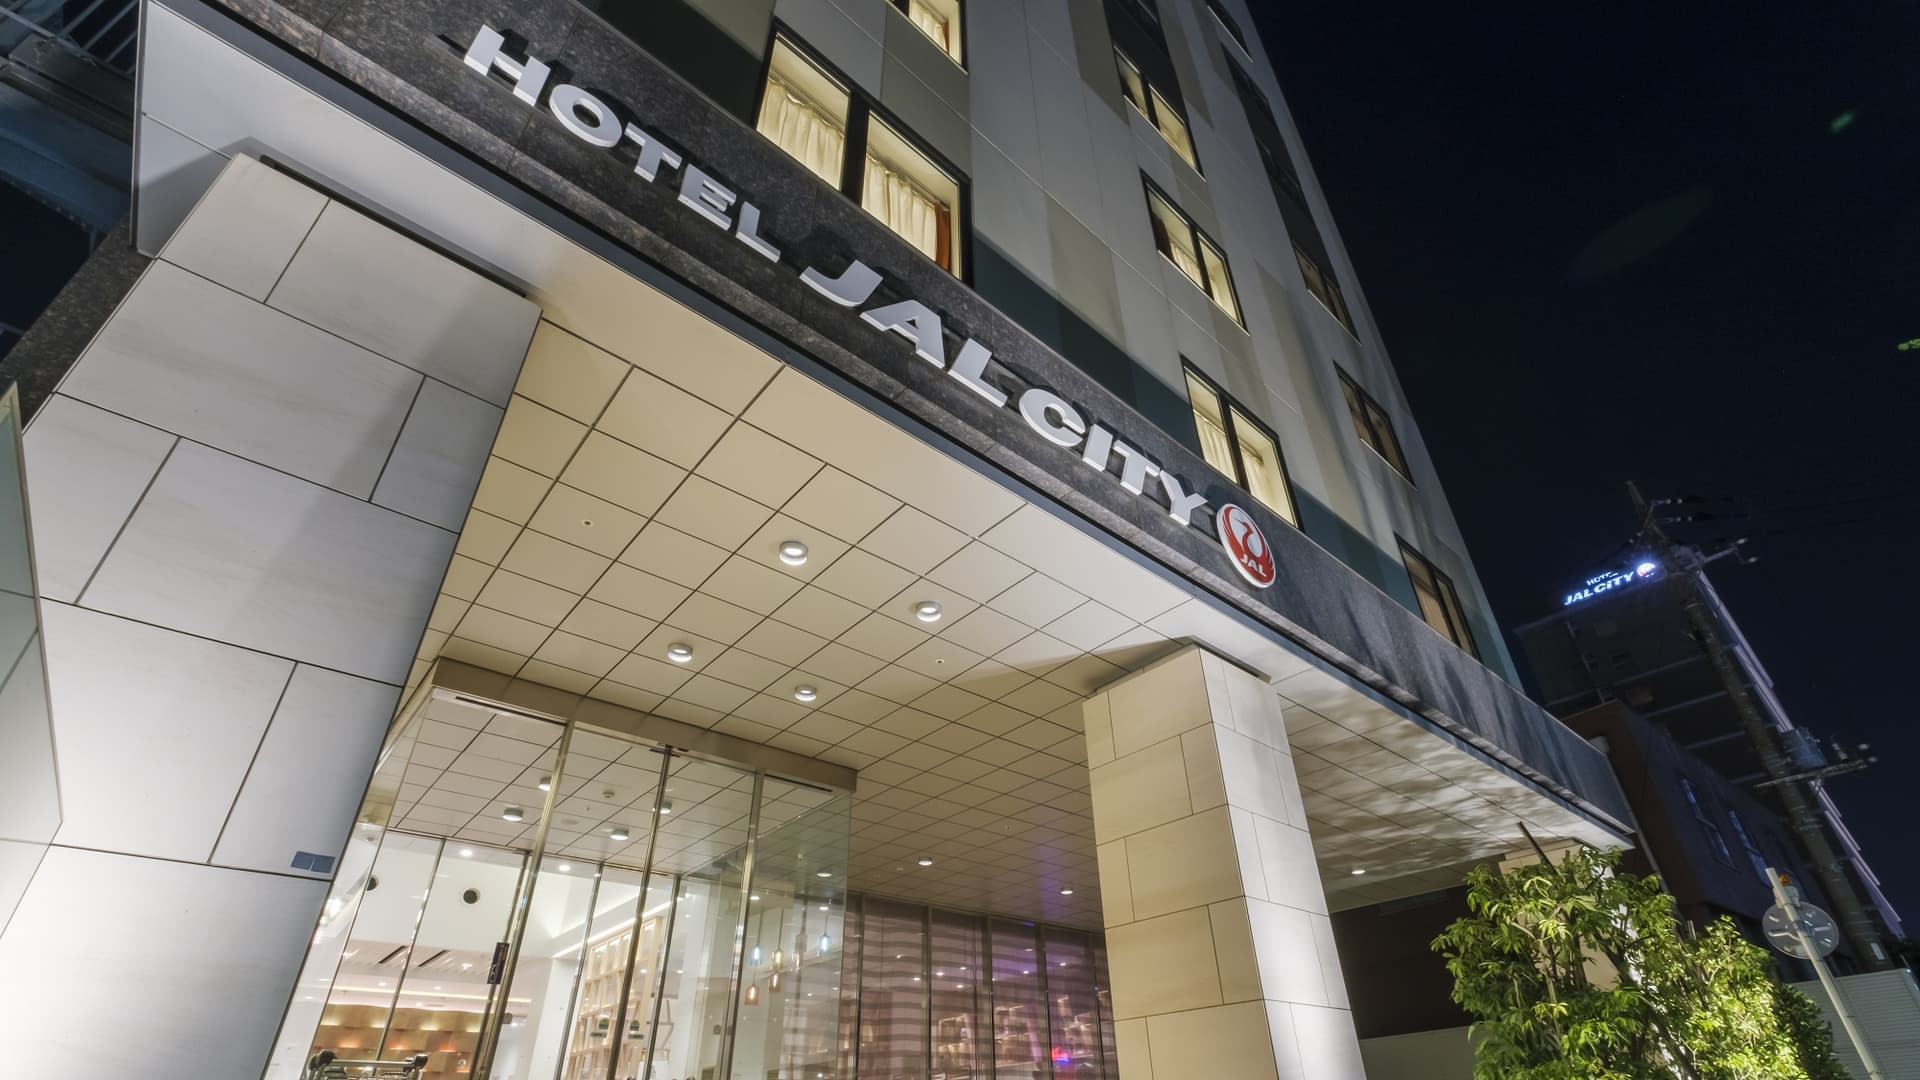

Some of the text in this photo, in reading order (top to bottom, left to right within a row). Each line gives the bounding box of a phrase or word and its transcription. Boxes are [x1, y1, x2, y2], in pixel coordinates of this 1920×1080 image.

[464, 24, 1208, 526] HOTEL JAL CITY
[1240, 553, 1267, 577] JAL
